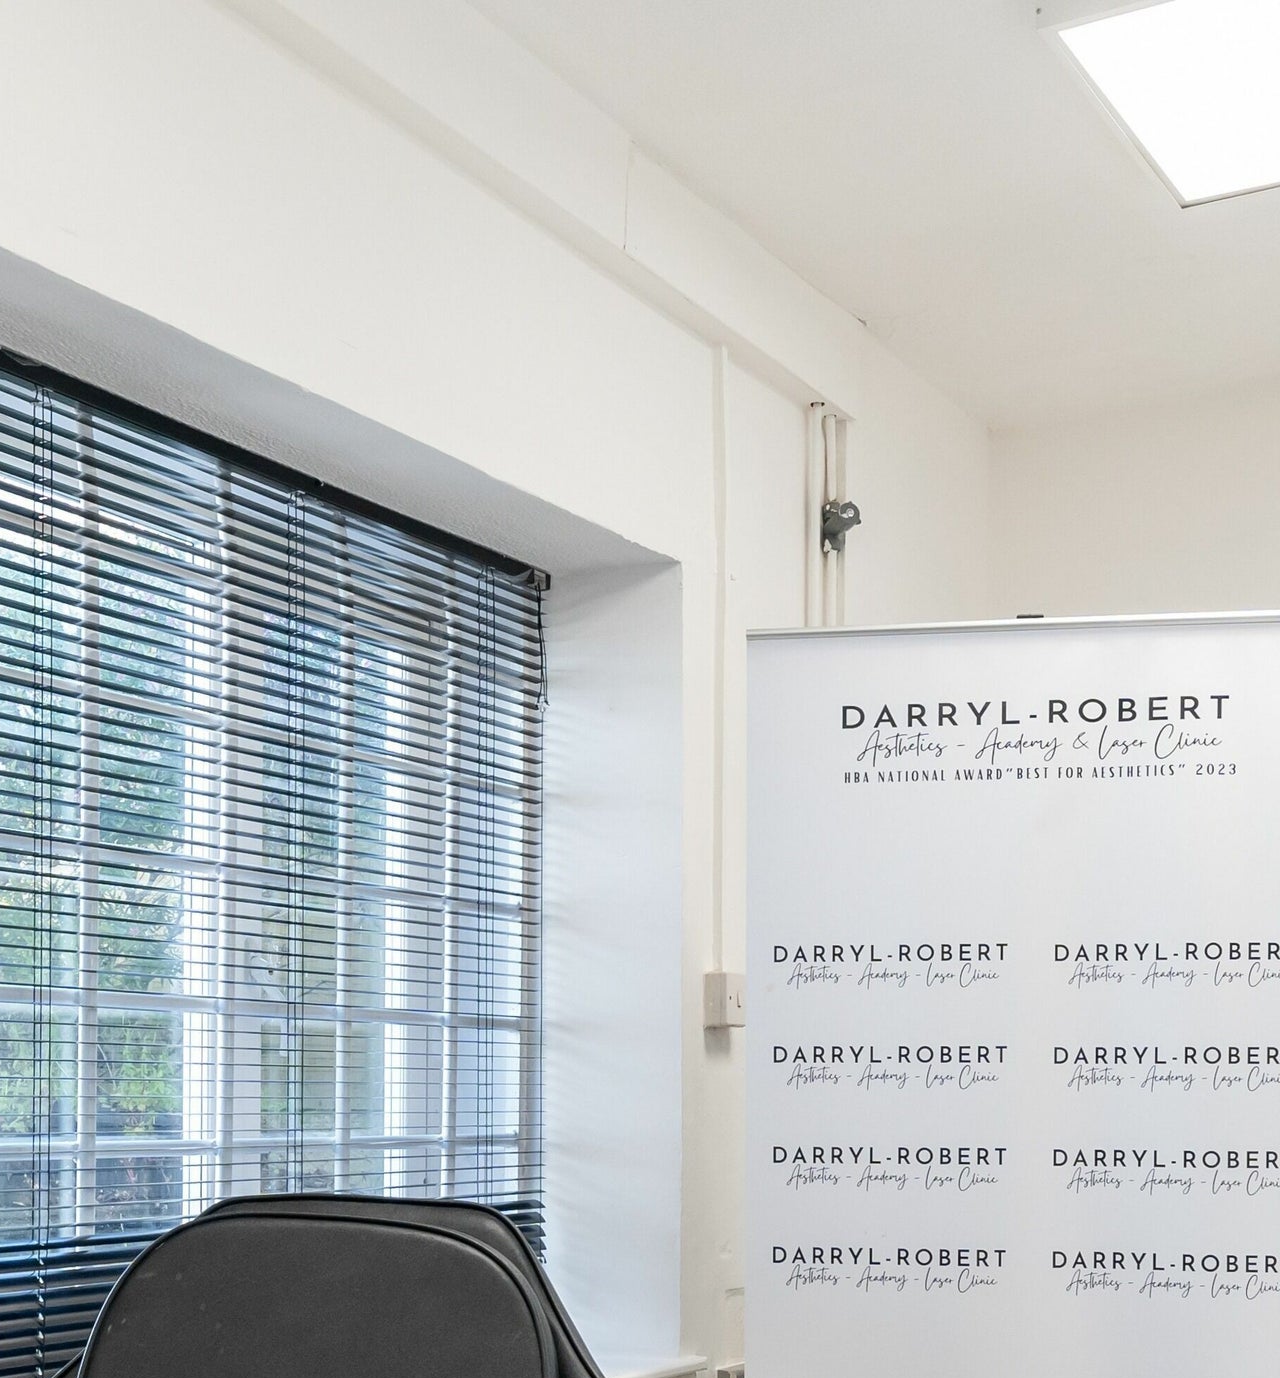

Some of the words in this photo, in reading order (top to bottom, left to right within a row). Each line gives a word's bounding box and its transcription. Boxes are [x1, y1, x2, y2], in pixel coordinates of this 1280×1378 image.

[842, 695, 1229, 729] DARRYL-ROBERT
[857, 730, 948, 767] Aesthetics
[975, 727, 1062, 765] Academy
[1072, 732, 1089, 749] &
[1099, 725, 1147, 760] Laser
[1154, 724, 1222, 759] Clinic
[844, 772, 869, 784] HBA
[878, 770, 946, 783] NATIONAL
[1058, 766, 1083, 779] FOR
[1196, 763, 1236, 776] 2023
[774, 943, 1008, 964] DARRYL-ROBERT
[787, 964, 843, 989] Aesthetics
[857, 964, 910, 989] Academy
[926, 963, 956, 987] Laser
[959, 962, 999, 988] Clinic
[1068, 964, 1125, 989] Aesthetics
[1141, 964, 1197, 988] Academy
[1214, 963, 1244, 986] Laser
[773, 1046, 1007, 1065] DARRYL-ROBERT
[787, 1066, 841, 1090] Aesthetics
[857, 1066, 910, 1091] Academy
[926, 1066, 955, 1088] Laser
[959, 1065, 999, 1090] Clinic
[1068, 1068, 1124, 1091] Aesthetics
[1139, 1068, 1196, 1092] Academy
[1213, 1068, 1243, 1091] Laser
[773, 1146, 1007, 1167] DARRYL-ROBERT
[785, 1167, 841, 1190] Aesthetics
[857, 1167, 909, 1191] Academy
[925, 1168, 954, 1190] Laser
[959, 1167, 998, 1191] Clinic
[1067, 1170, 1123, 1194] Aesthetics
[1140, 1171, 1195, 1195] Academy
[1212, 1171, 1242, 1195] Laser
[773, 1246, 1006, 1269] DARRYL-ROBERT
[786, 1267, 840, 1290] Aesthetics
[856, 1268, 908, 1292] Academy
[925, 1269, 954, 1291] Laser
[958, 1269, 998, 1293] Clinic
[1066, 1272, 1123, 1296] Aesthetics
[1139, 1274, 1195, 1298] Academy
[1211, 1275, 1241, 1298] Laser
